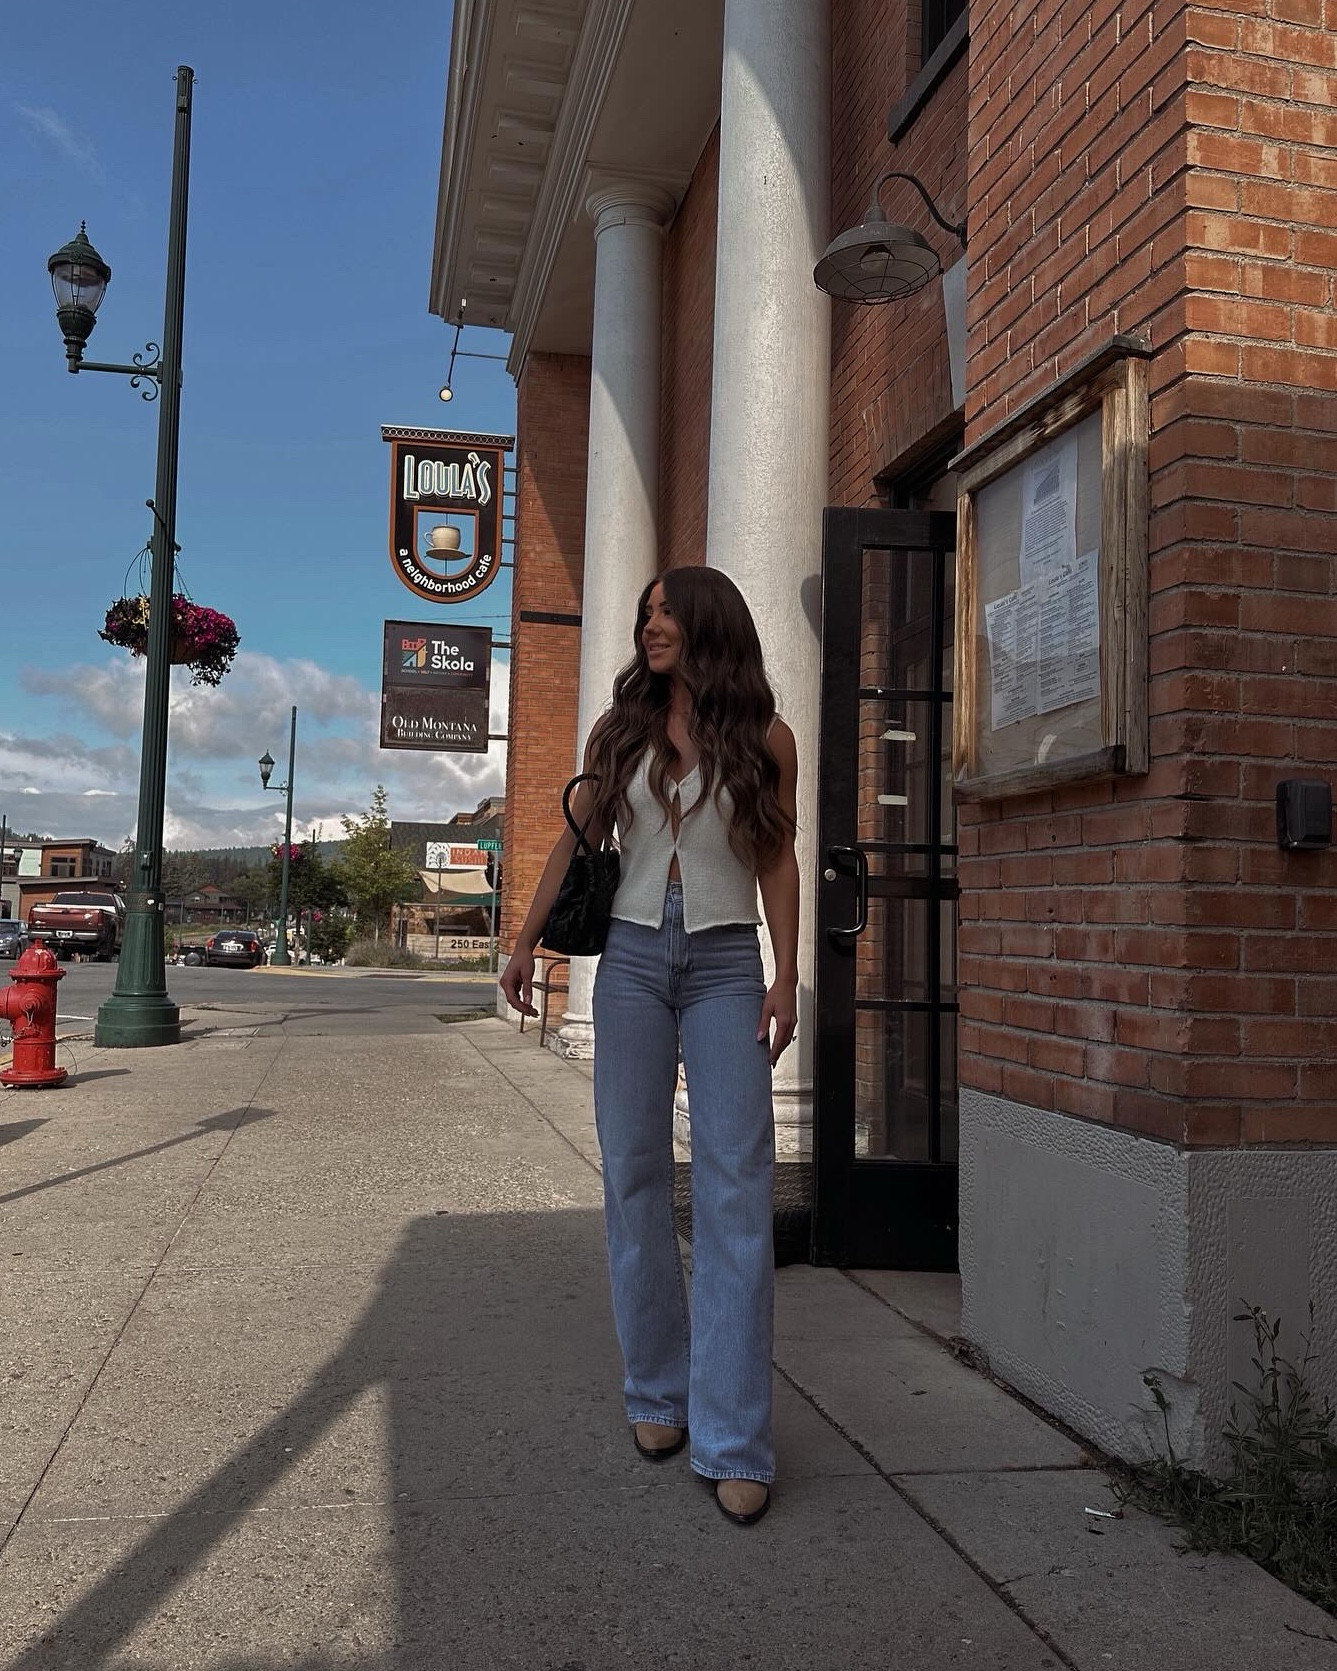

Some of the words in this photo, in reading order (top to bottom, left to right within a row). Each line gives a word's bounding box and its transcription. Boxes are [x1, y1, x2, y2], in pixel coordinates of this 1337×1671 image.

[403, 452, 492, 506] LOULA'S
[399, 548, 408, 557] a
[477, 554, 492, 578] cafe
[402, 558, 477, 593] neighborhood
[431, 640, 460, 656] The
[431, 655, 474, 671] Skola
[392, 715, 419, 729] OLD
[422, 716, 477, 732] MONTANA
[451, 939, 470, 949] 250
